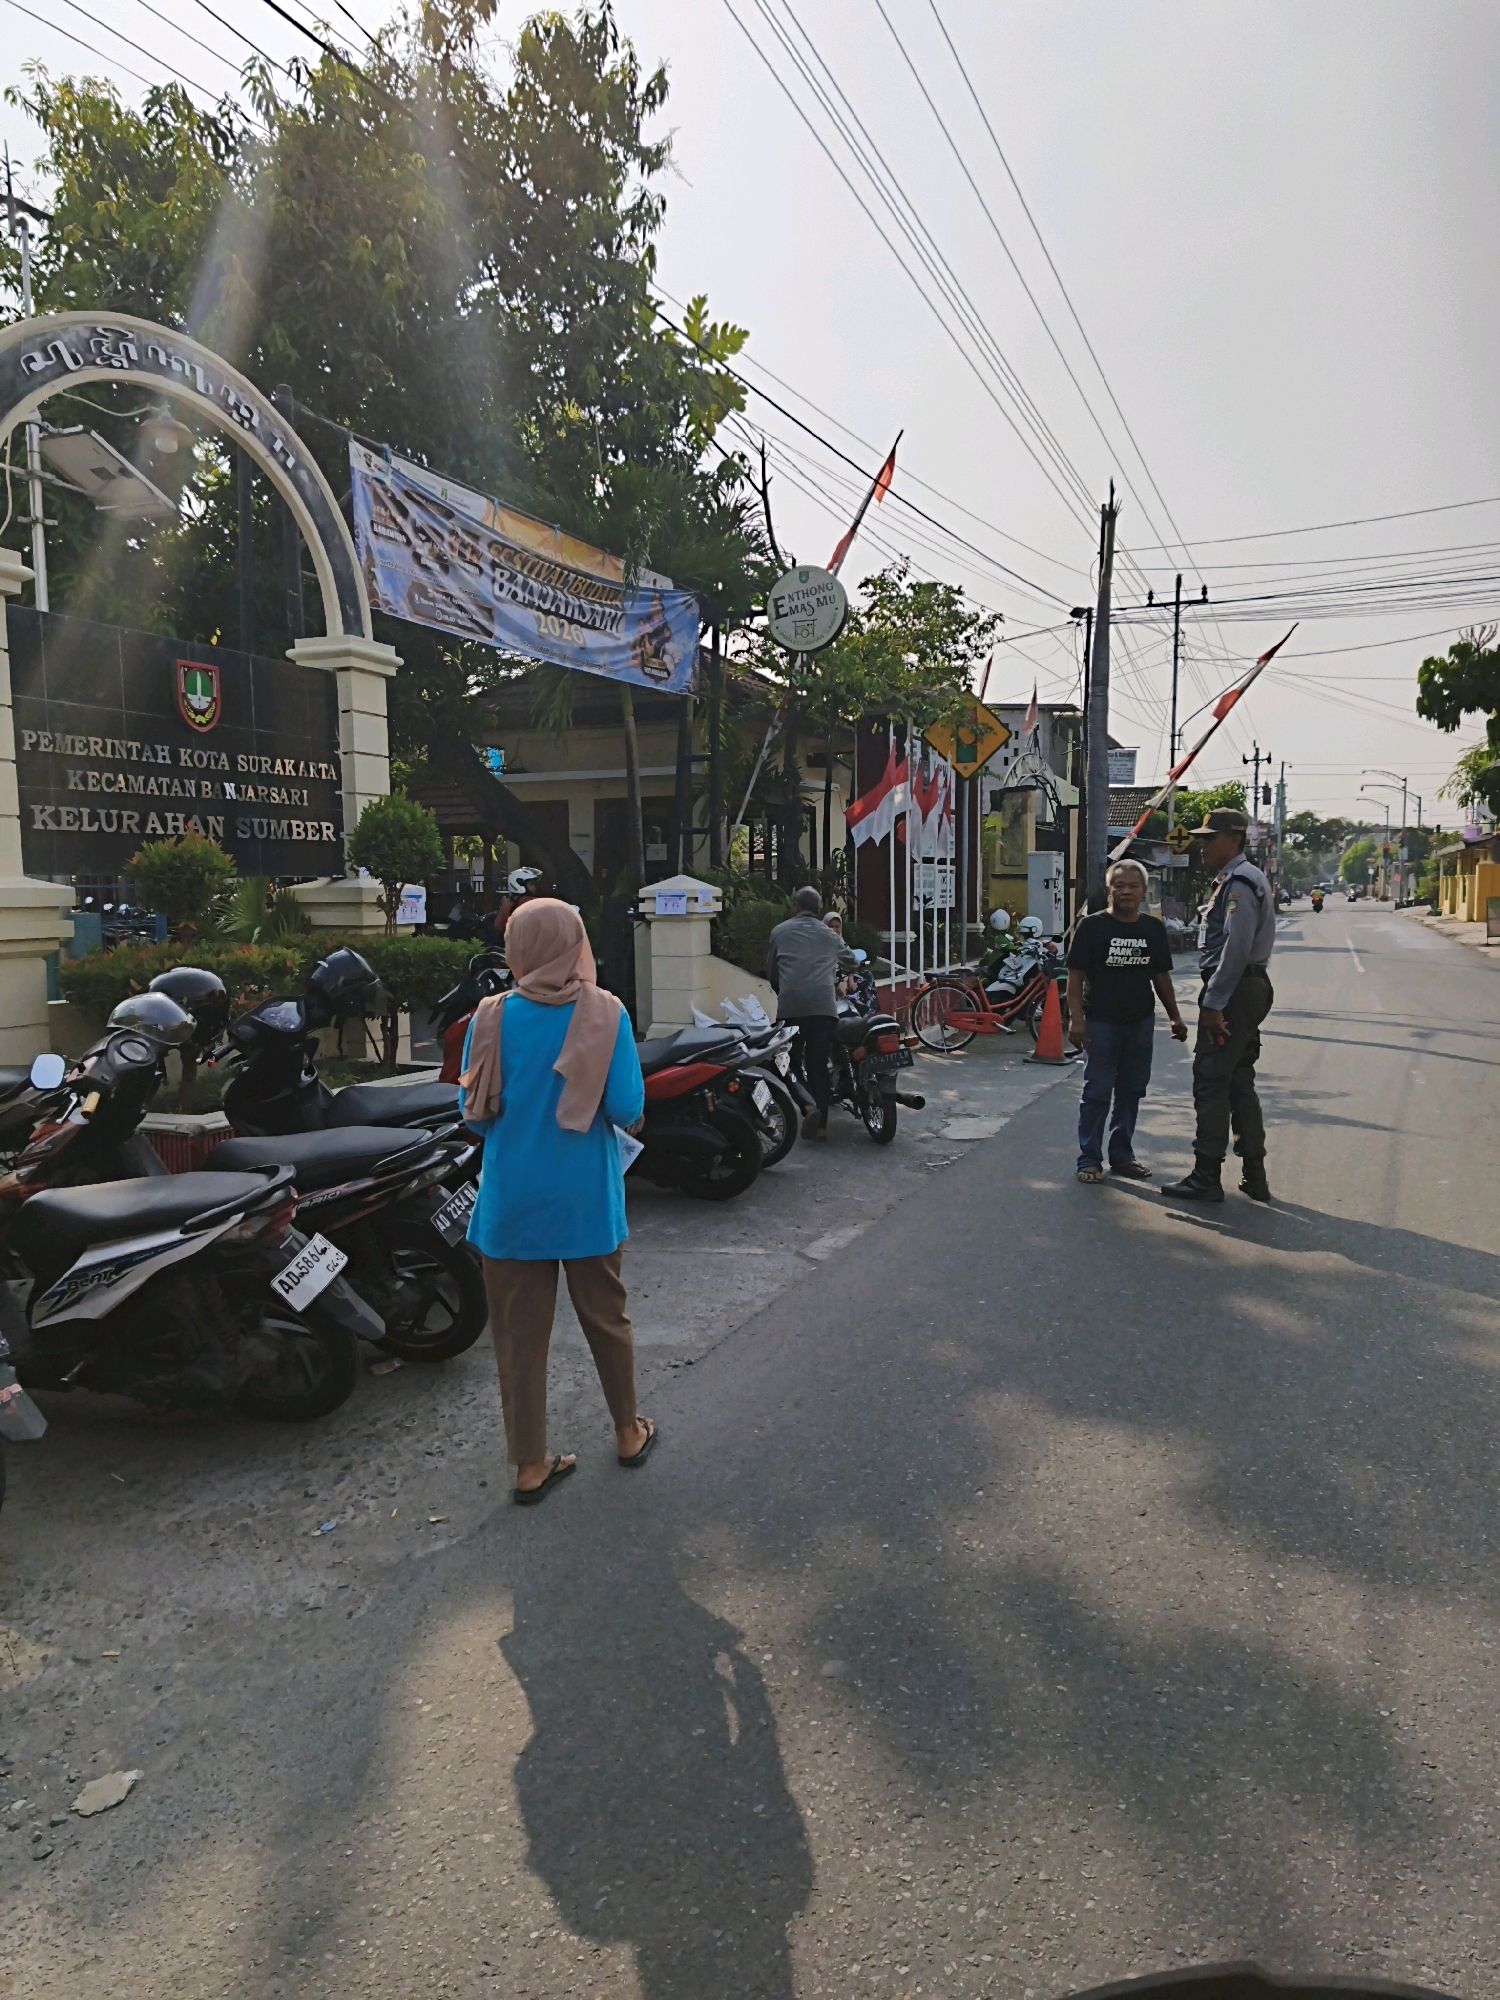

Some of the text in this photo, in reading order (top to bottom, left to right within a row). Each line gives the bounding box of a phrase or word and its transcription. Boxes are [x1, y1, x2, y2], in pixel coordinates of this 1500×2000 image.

[489, 543, 568, 589] FESTIVAL
[493, 567, 624, 635] BANJARSARI
[816, 595, 836, 608] MU
[534, 611, 585, 645] 2026
[22, 729, 338, 781] PEMERINTAH KOTA SURAKARTA
[67, 769, 309, 807] KECAMATAN BANJARSARI
[31, 804, 337, 842] KELURAHAN SUMBER
[1108, 946, 1133, 956] PARK
[1110, 937, 1148, 947] CENTRAL
[1105, 956, 1151, 965] ATHLETICS
[435, 1213, 451, 1232] AD
[277, 1271, 301, 1295] AD
